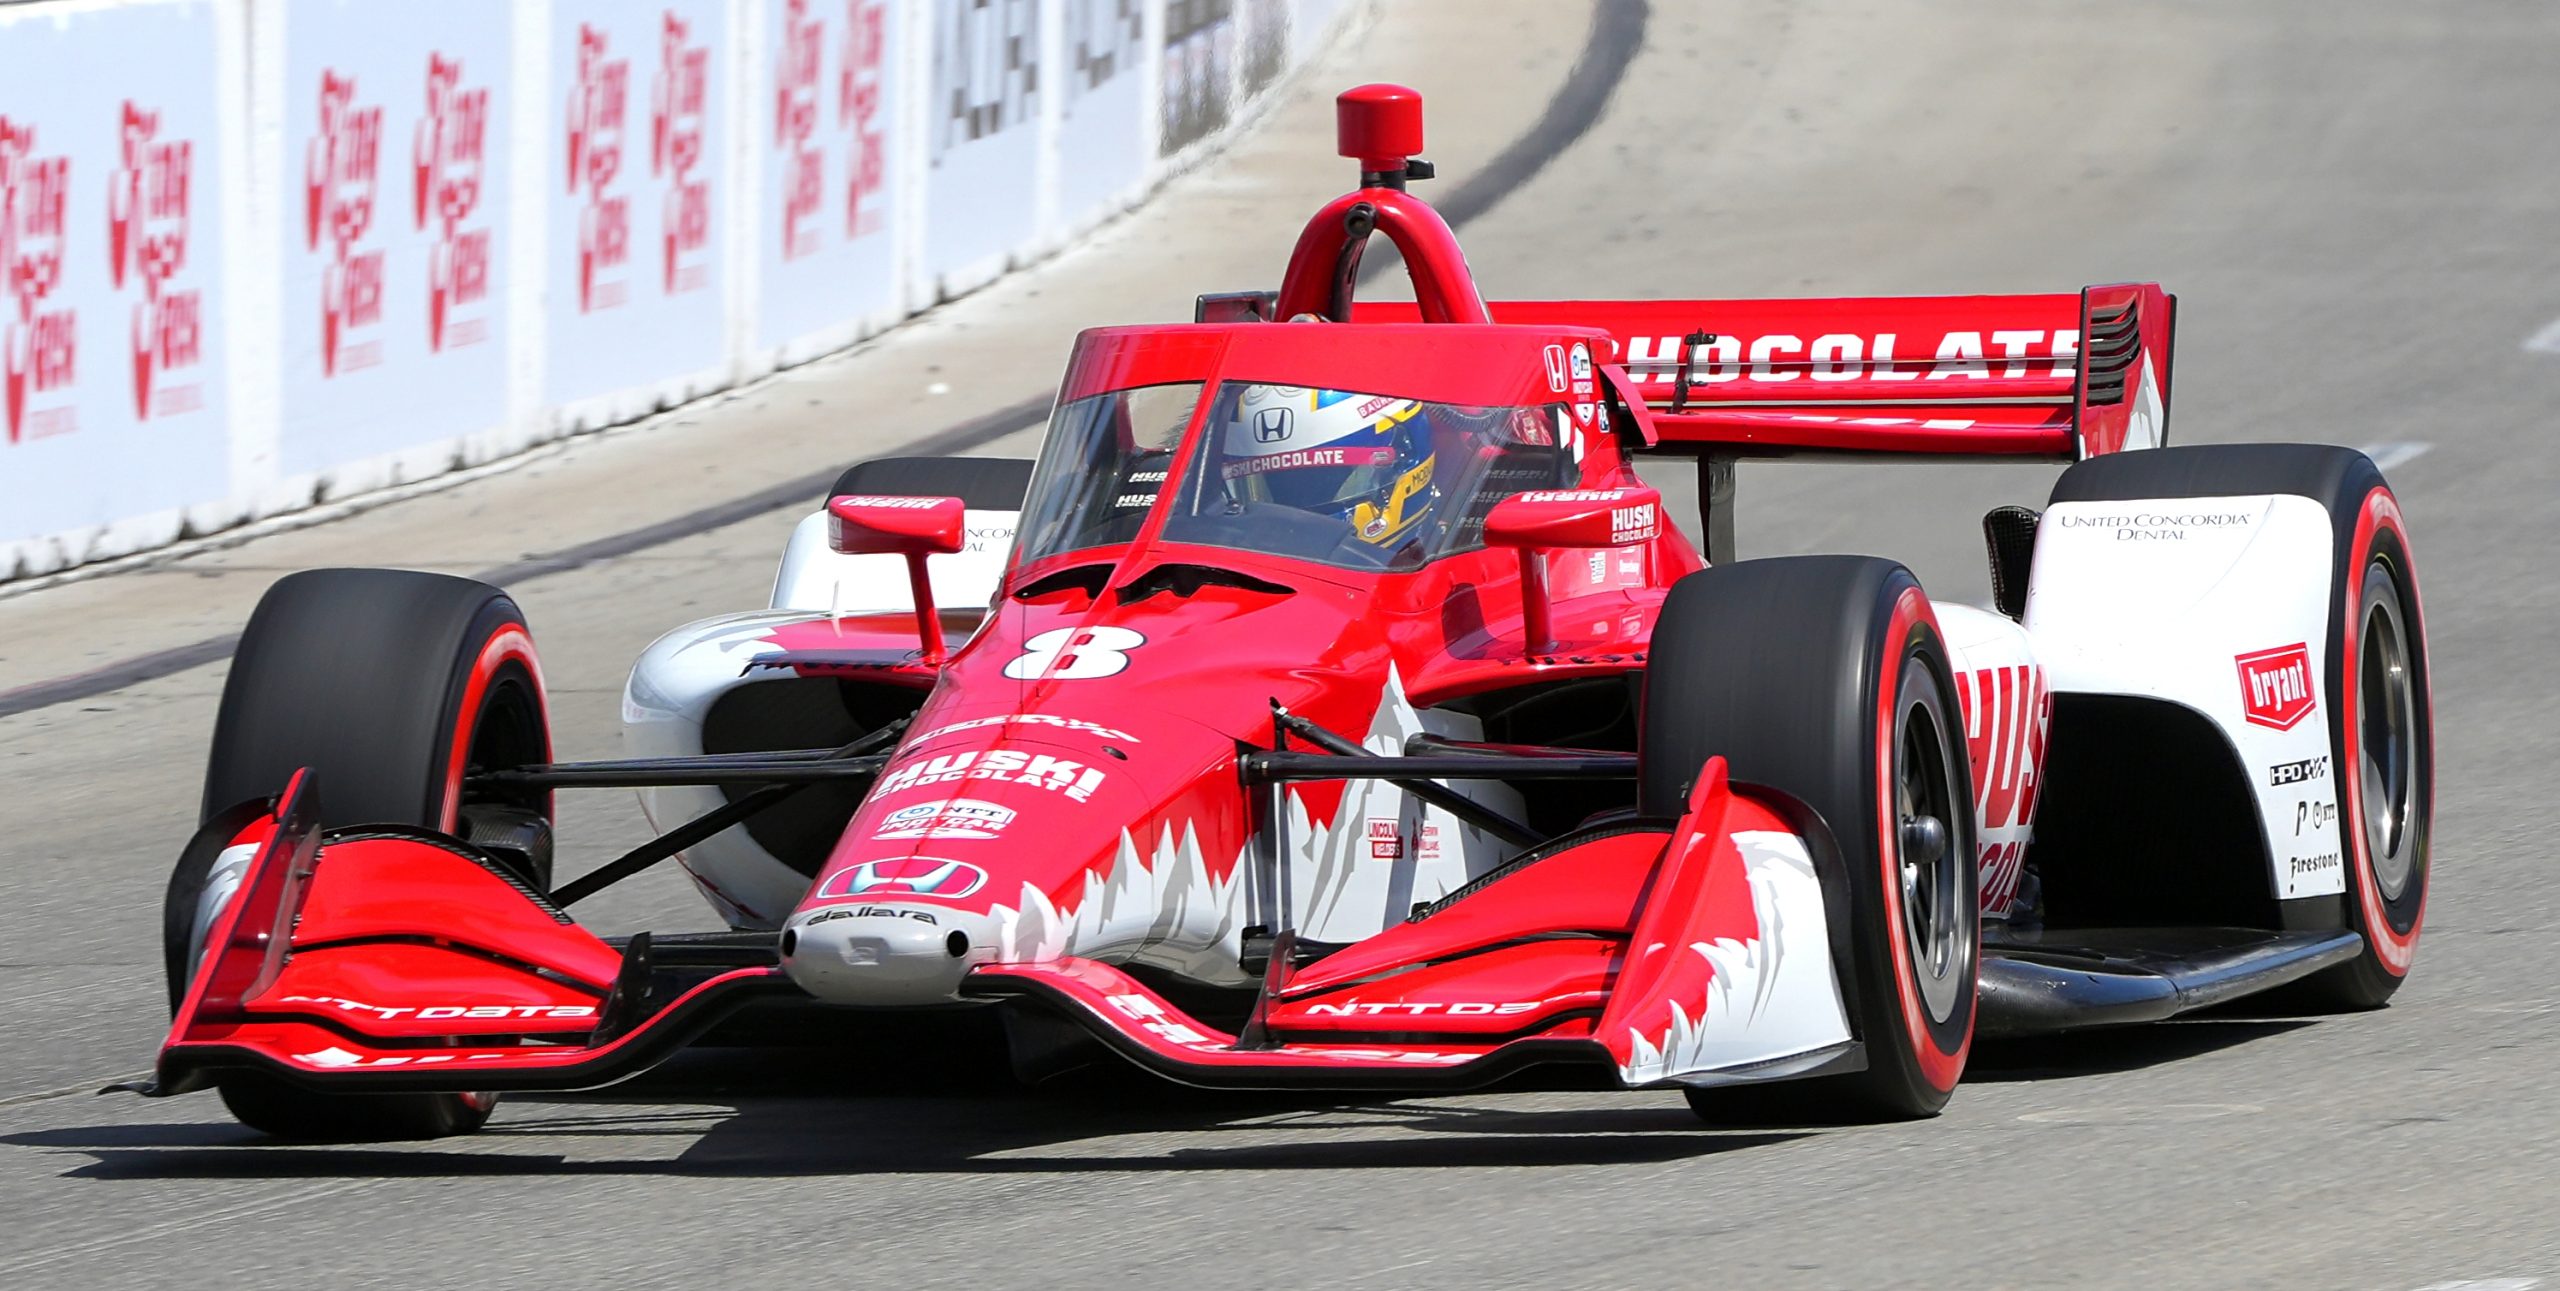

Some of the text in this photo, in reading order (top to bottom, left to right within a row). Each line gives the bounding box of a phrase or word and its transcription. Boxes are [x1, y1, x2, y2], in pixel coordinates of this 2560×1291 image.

[1612, 331, 2080, 383] HOCOLATE
[1252, 450, 1344, 473] CHOCOLATE
[1611, 503, 1655, 532] HUSKI
[2061, 514, 2248, 528] UNITED CONCORDIA
[1611, 526, 1655, 545] CHOCOLATE
[2117, 528, 2187, 541] DENTAL
[1001, 625, 1148, 680] 8
[2248, 659, 2307, 711] bryant
[879, 750, 1106, 794] HUSKI
[2271, 764, 2303, 785] HPD
[869, 768, 1093, 803] CHOCOLATE
[948, 806, 1001, 817] NTT
[2290, 853, 2338, 878] Firestone
[807, 906, 938, 926] dallara
[1306, 1001, 1436, 1016] NTT
